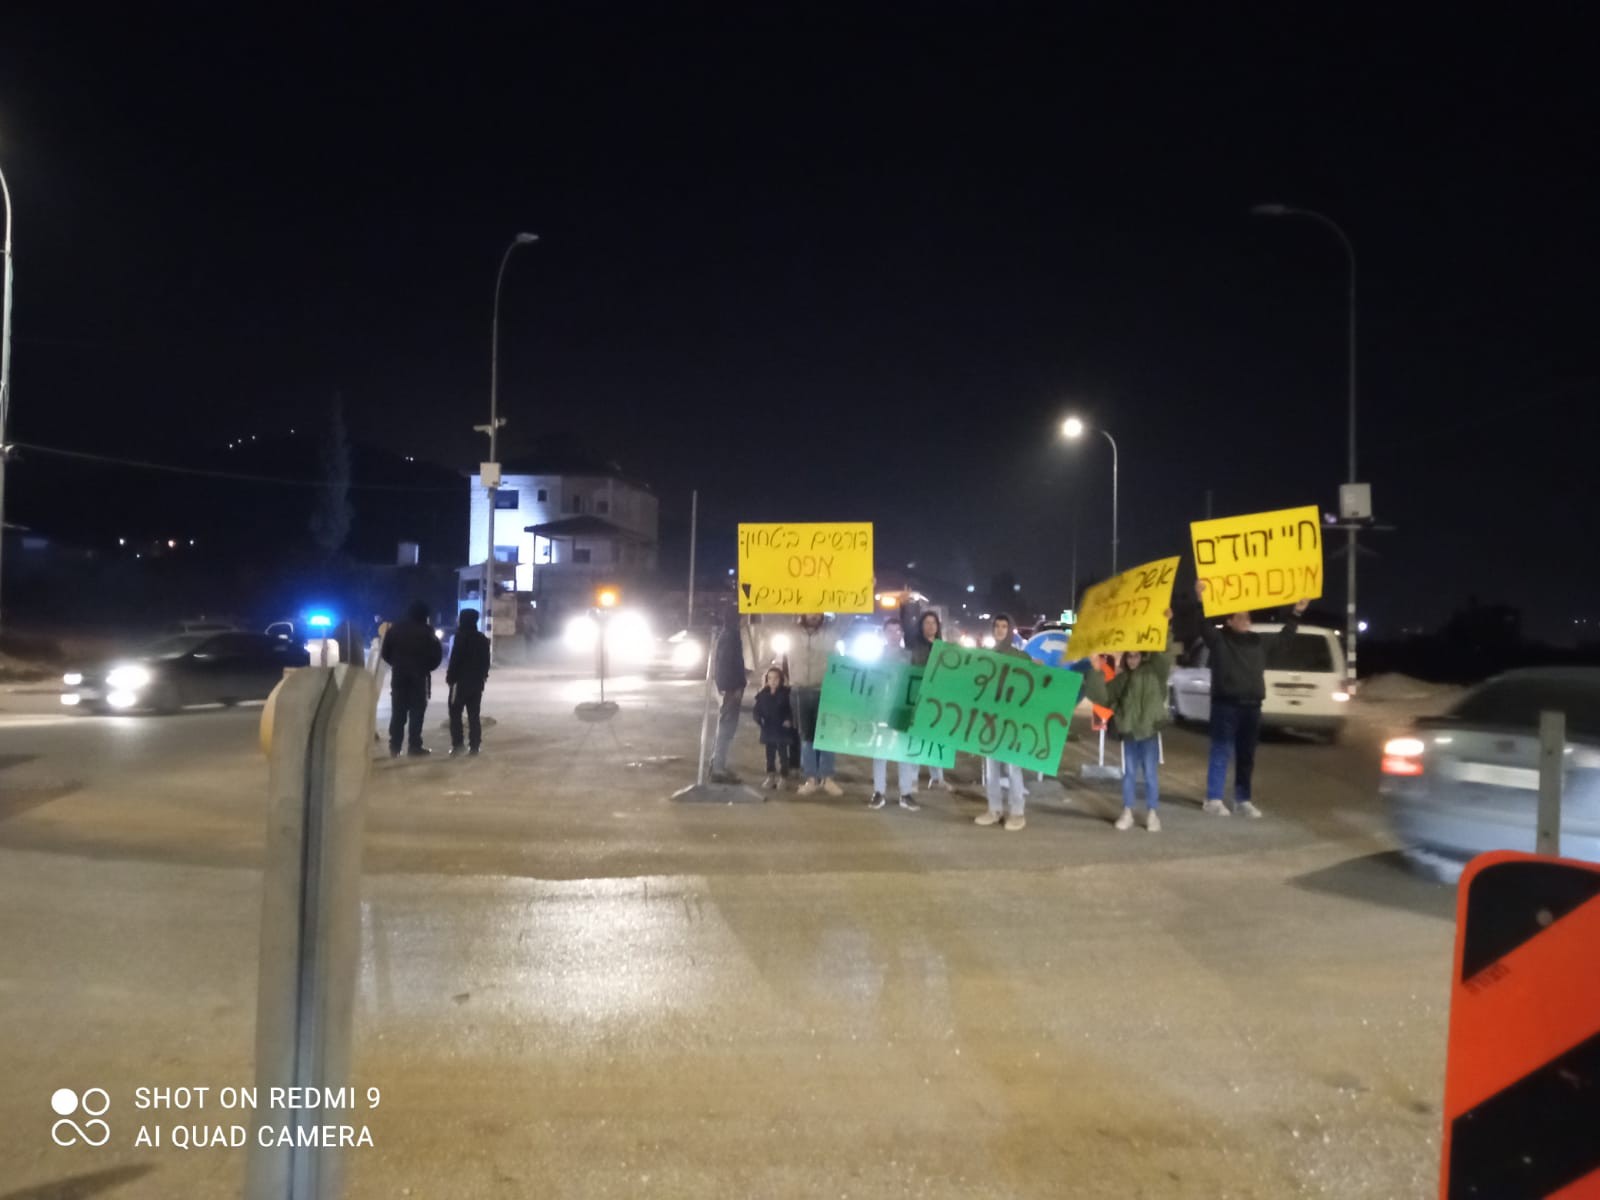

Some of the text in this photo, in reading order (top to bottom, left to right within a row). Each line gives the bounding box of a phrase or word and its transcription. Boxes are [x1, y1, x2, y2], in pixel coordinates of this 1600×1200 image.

[810, 530, 868, 551] דורשים
[1196, 520, 1317, 565] חיי יהודים
[787, 555, 834, 580] אפס
[1134, 564, 1174, 593] אשר
[1199, 564, 1319, 606] אינם הפקר
[929, 649, 1053, 707] יהודים
[926, 697, 1068, 760] להתעורר
